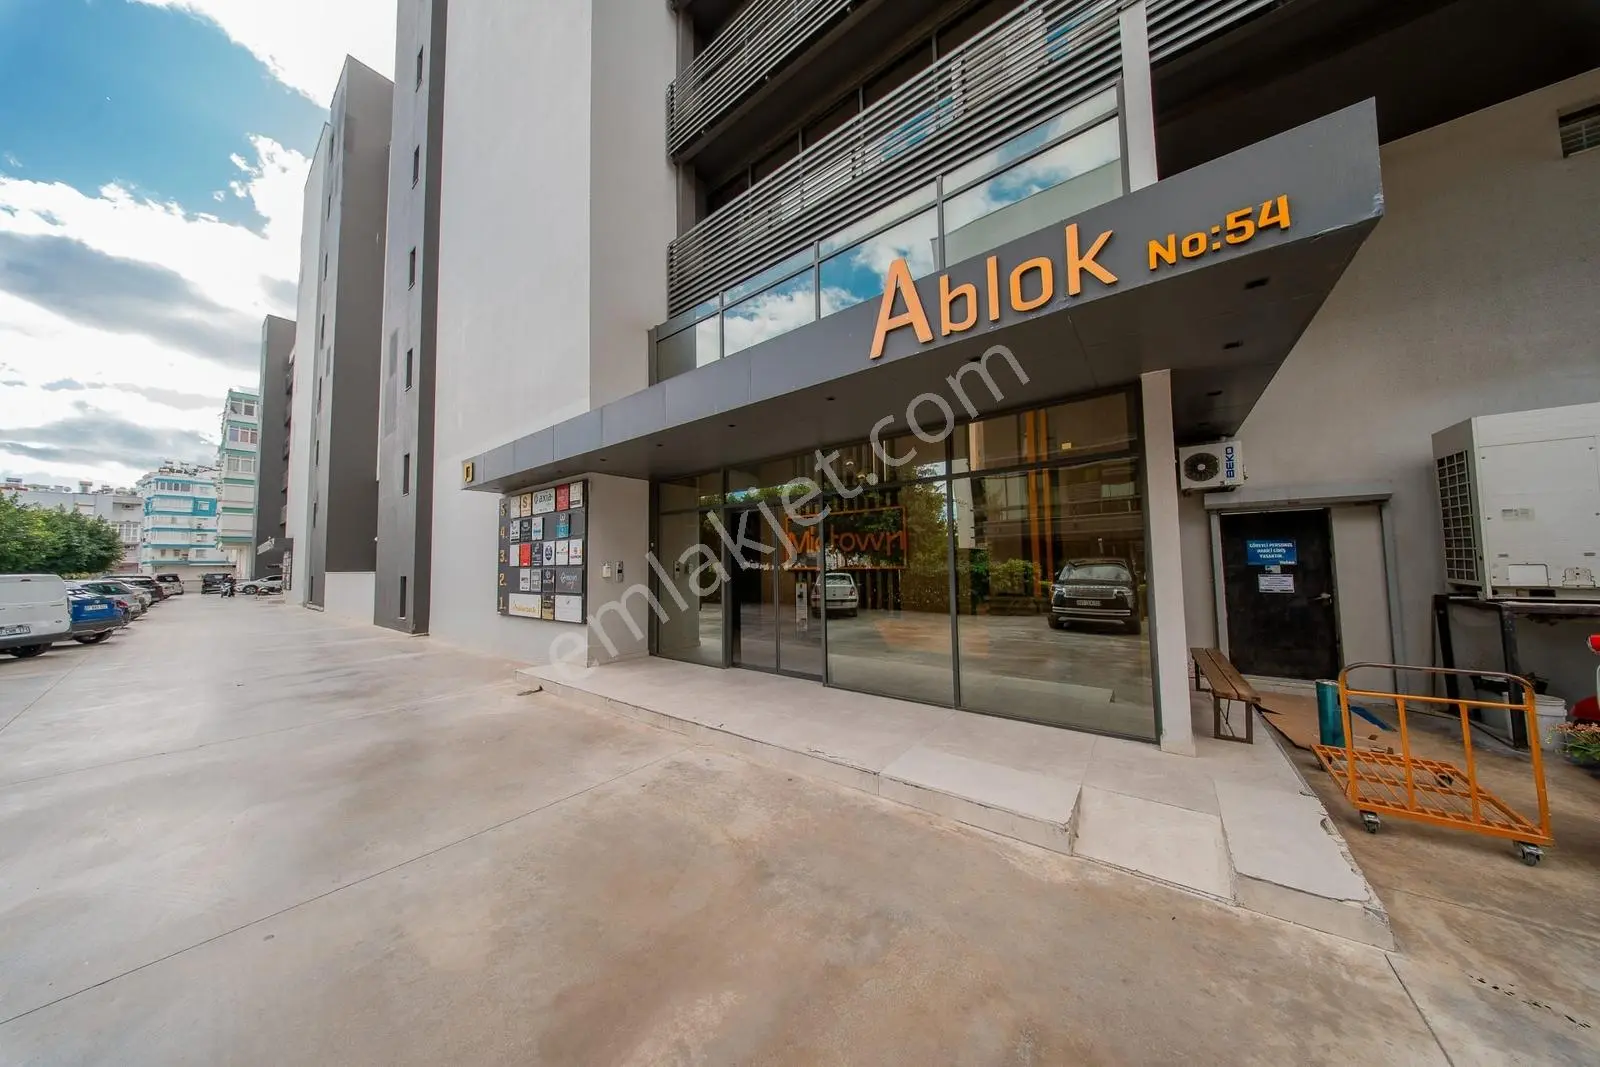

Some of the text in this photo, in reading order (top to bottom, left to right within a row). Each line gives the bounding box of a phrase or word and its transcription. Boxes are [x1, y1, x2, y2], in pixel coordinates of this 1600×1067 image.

[1147, 194, 1292, 270] No:54
[1225, 446, 1235, 478] BEKO
[787, 524, 906, 557] Mitown
